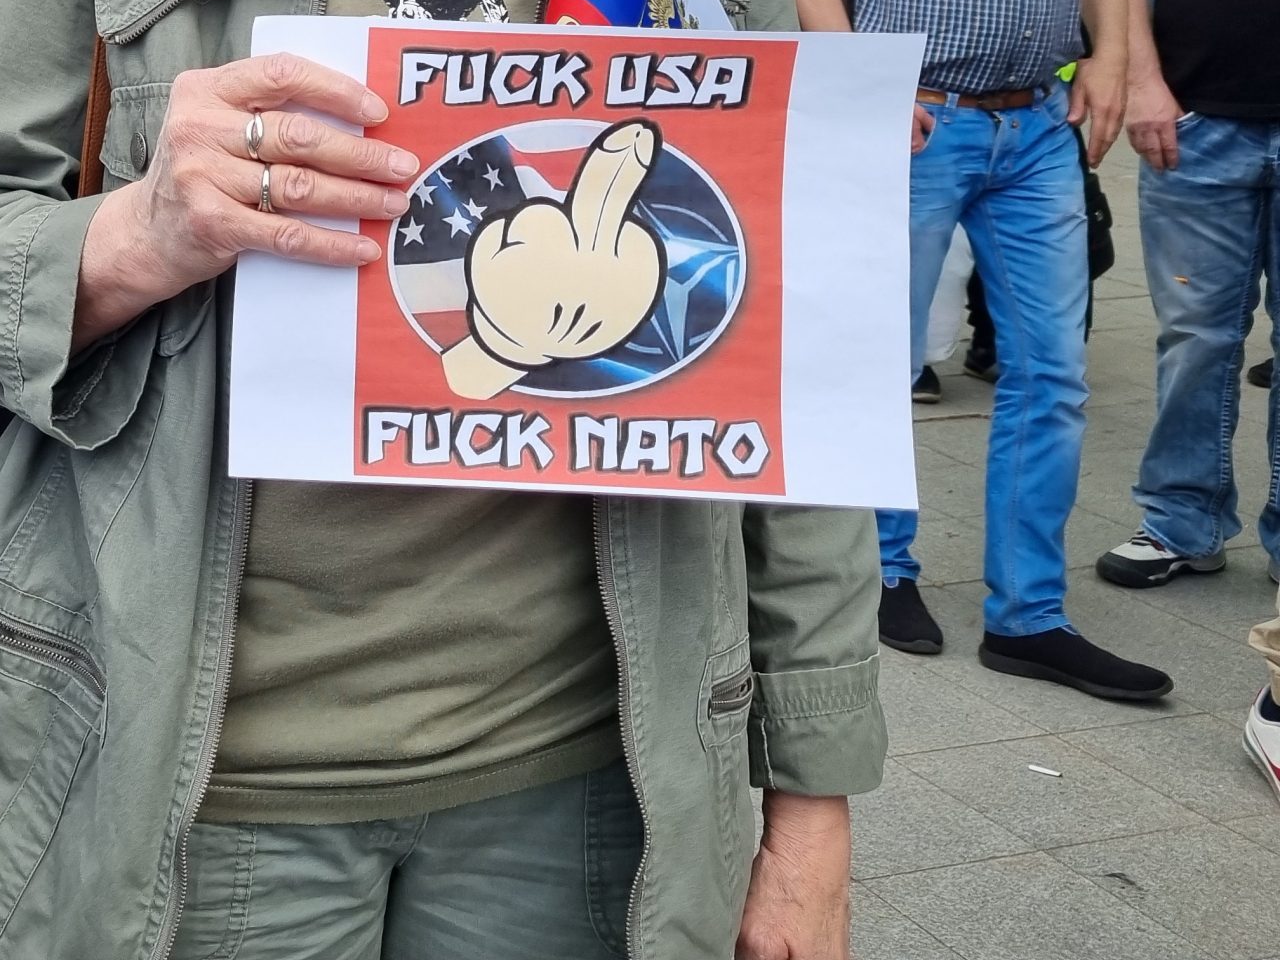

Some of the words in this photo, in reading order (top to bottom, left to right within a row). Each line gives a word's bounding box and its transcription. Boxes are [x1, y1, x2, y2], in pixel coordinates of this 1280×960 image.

[398, 51, 588, 107] FUCK
[604, 53, 750, 108] USA
[366, 410, 556, 471] FUCK
[573, 414, 771, 477] NATO
